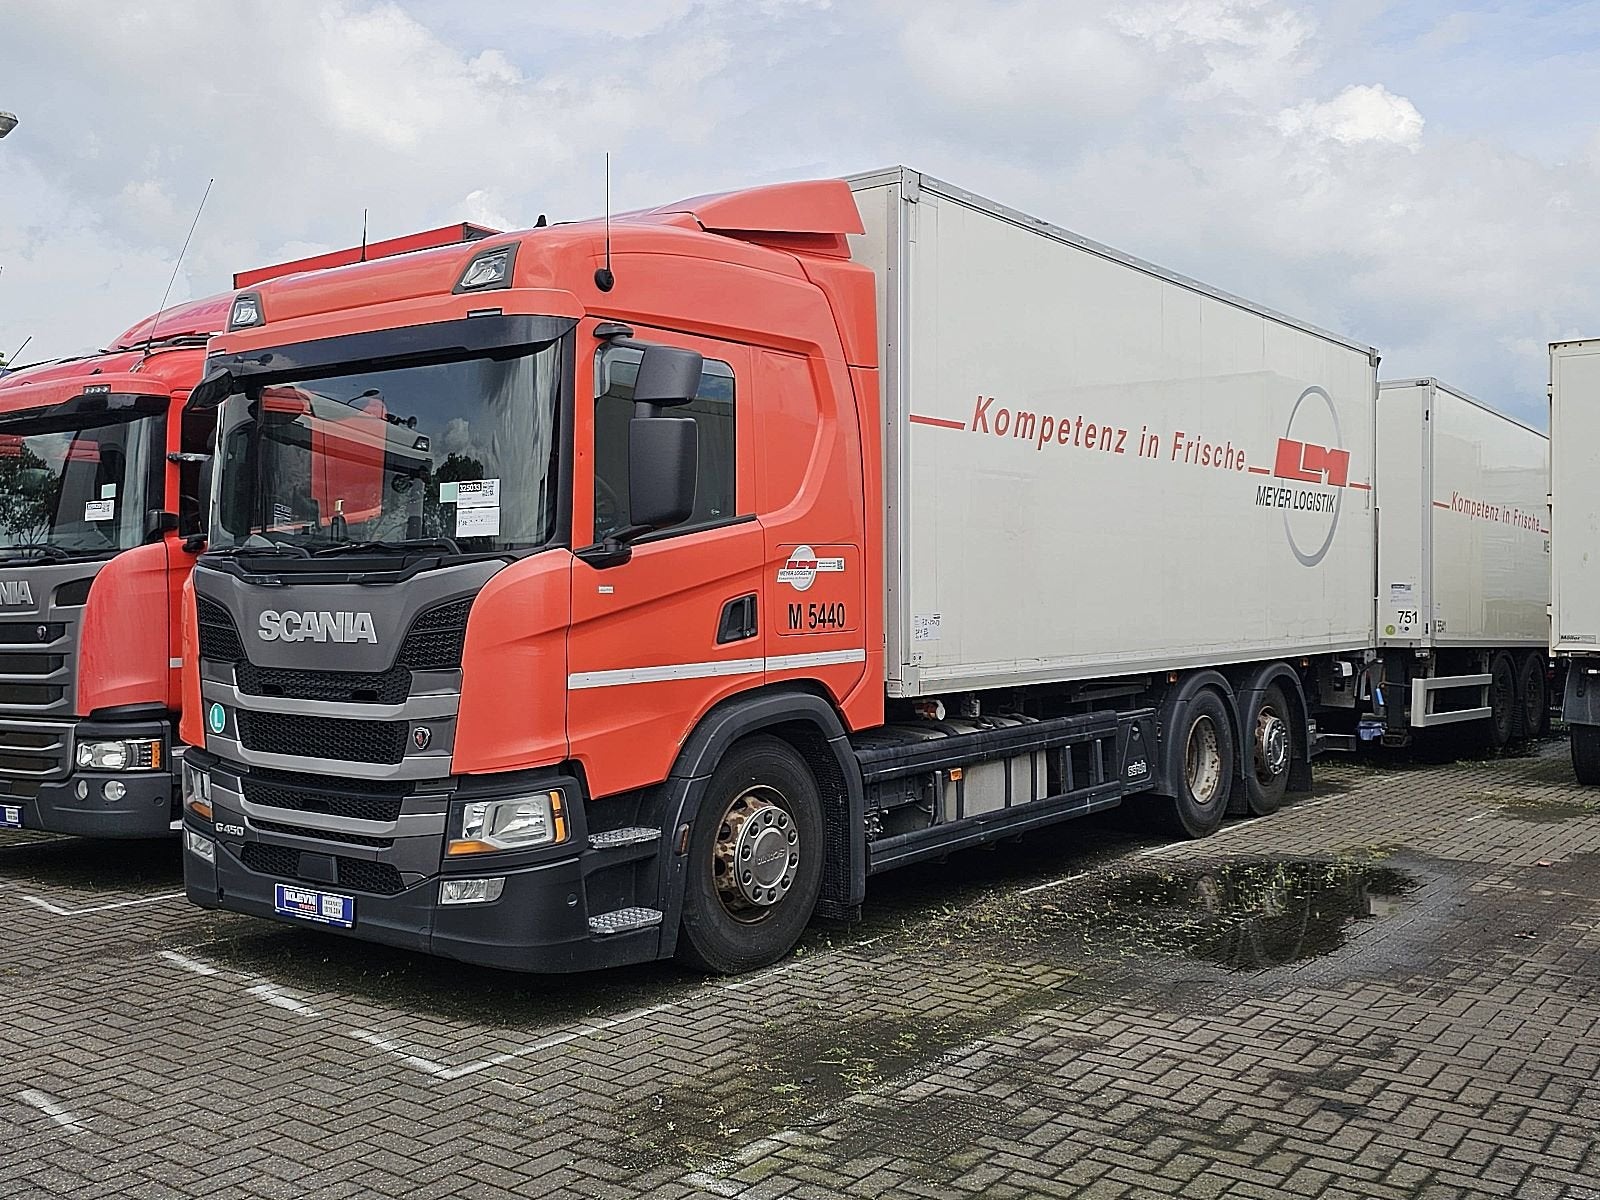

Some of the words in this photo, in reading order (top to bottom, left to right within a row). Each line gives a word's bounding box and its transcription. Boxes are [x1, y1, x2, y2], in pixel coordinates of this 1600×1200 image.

[971, 395, 1128, 454] Kompetenz
[1139, 425, 1160, 459] in
[1171, 431, 1246, 472] Frische
[1273, 437, 1350, 488] LM
[1255, 485, 1292, 509] MEYER
[1293, 490, 1336, 513] LOGISTIK
[1451, 490, 1499, 521] Kompetenz
[1502, 505, 1510, 524] in
[1513, 508, 1540, 532] Frische
[258, 610, 378, 643] SCANIA
[788, 603, 803, 629] M
[808, 603, 845, 629] 5440
[1397, 611, 1418, 624] 751
[214, 708, 222, 728] L
[285, 890, 316, 906] KLEYN
